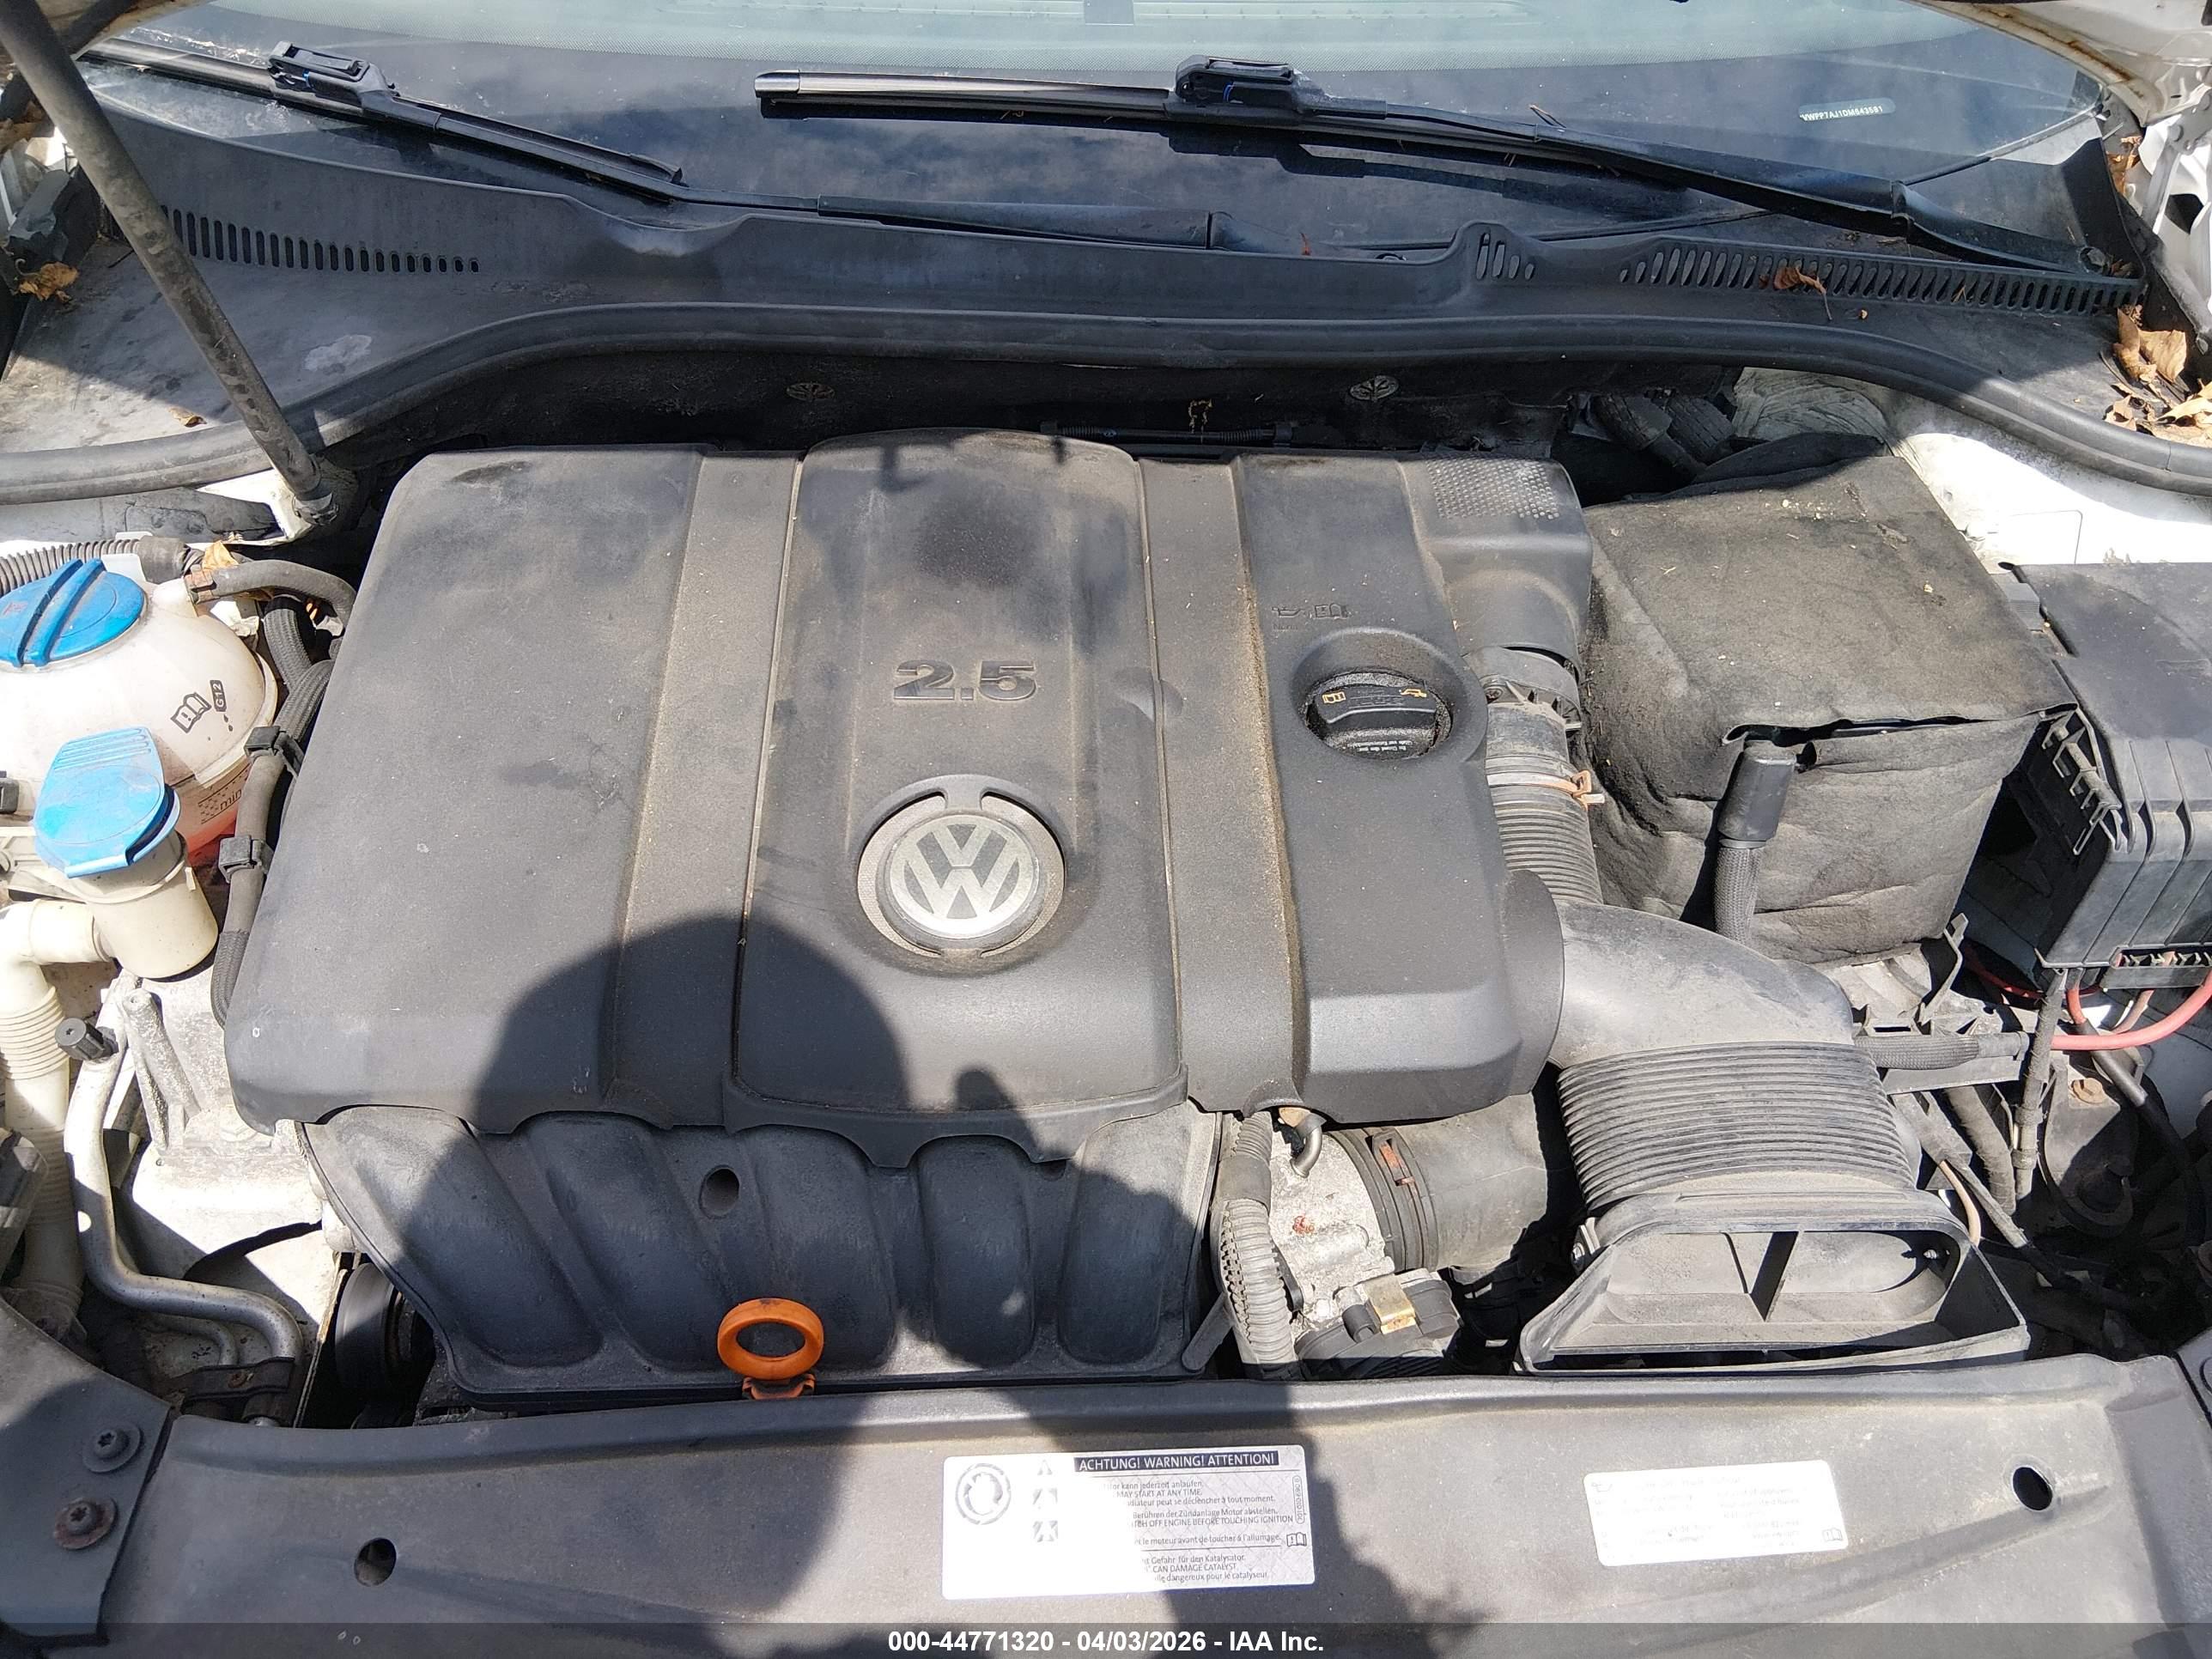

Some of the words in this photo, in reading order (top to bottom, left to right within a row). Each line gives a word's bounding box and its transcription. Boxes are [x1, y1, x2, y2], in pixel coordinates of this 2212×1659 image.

[893, 659, 1038, 702] 2.5
[212, 683, 225, 708] G12
[220, 788, 241, 811] min
[890, 813, 1036, 939] VW
[1079, 1457, 1140, 1471] ACHTUNG!
[1144, 1455, 1205, 1468] WARNING!
[1207, 1453, 1274, 1466] ATTENTION!
[1134, 1490, 1155, 1498] START
[1157, 1498, 1172, 1508] peut
[1221, 1508, 1243, 1516] Motor
[1149, 1519, 1163, 1528] OFF
[1164, 1518, 1191, 1527] ENGINE
[1193, 1517, 1219, 1526] BEFORE
[1221, 1516, 1259, 1525] TOUCHING
[1261, 1514, 1293, 1524] IGNITION
[1151, 1556, 1176, 1565] Gefahr
[1170, 1564, 1203, 1573] DAMAGE
[1167, 1573, 1205, 1583] dangereux
[1206, 1573, 1223, 1583] pour
